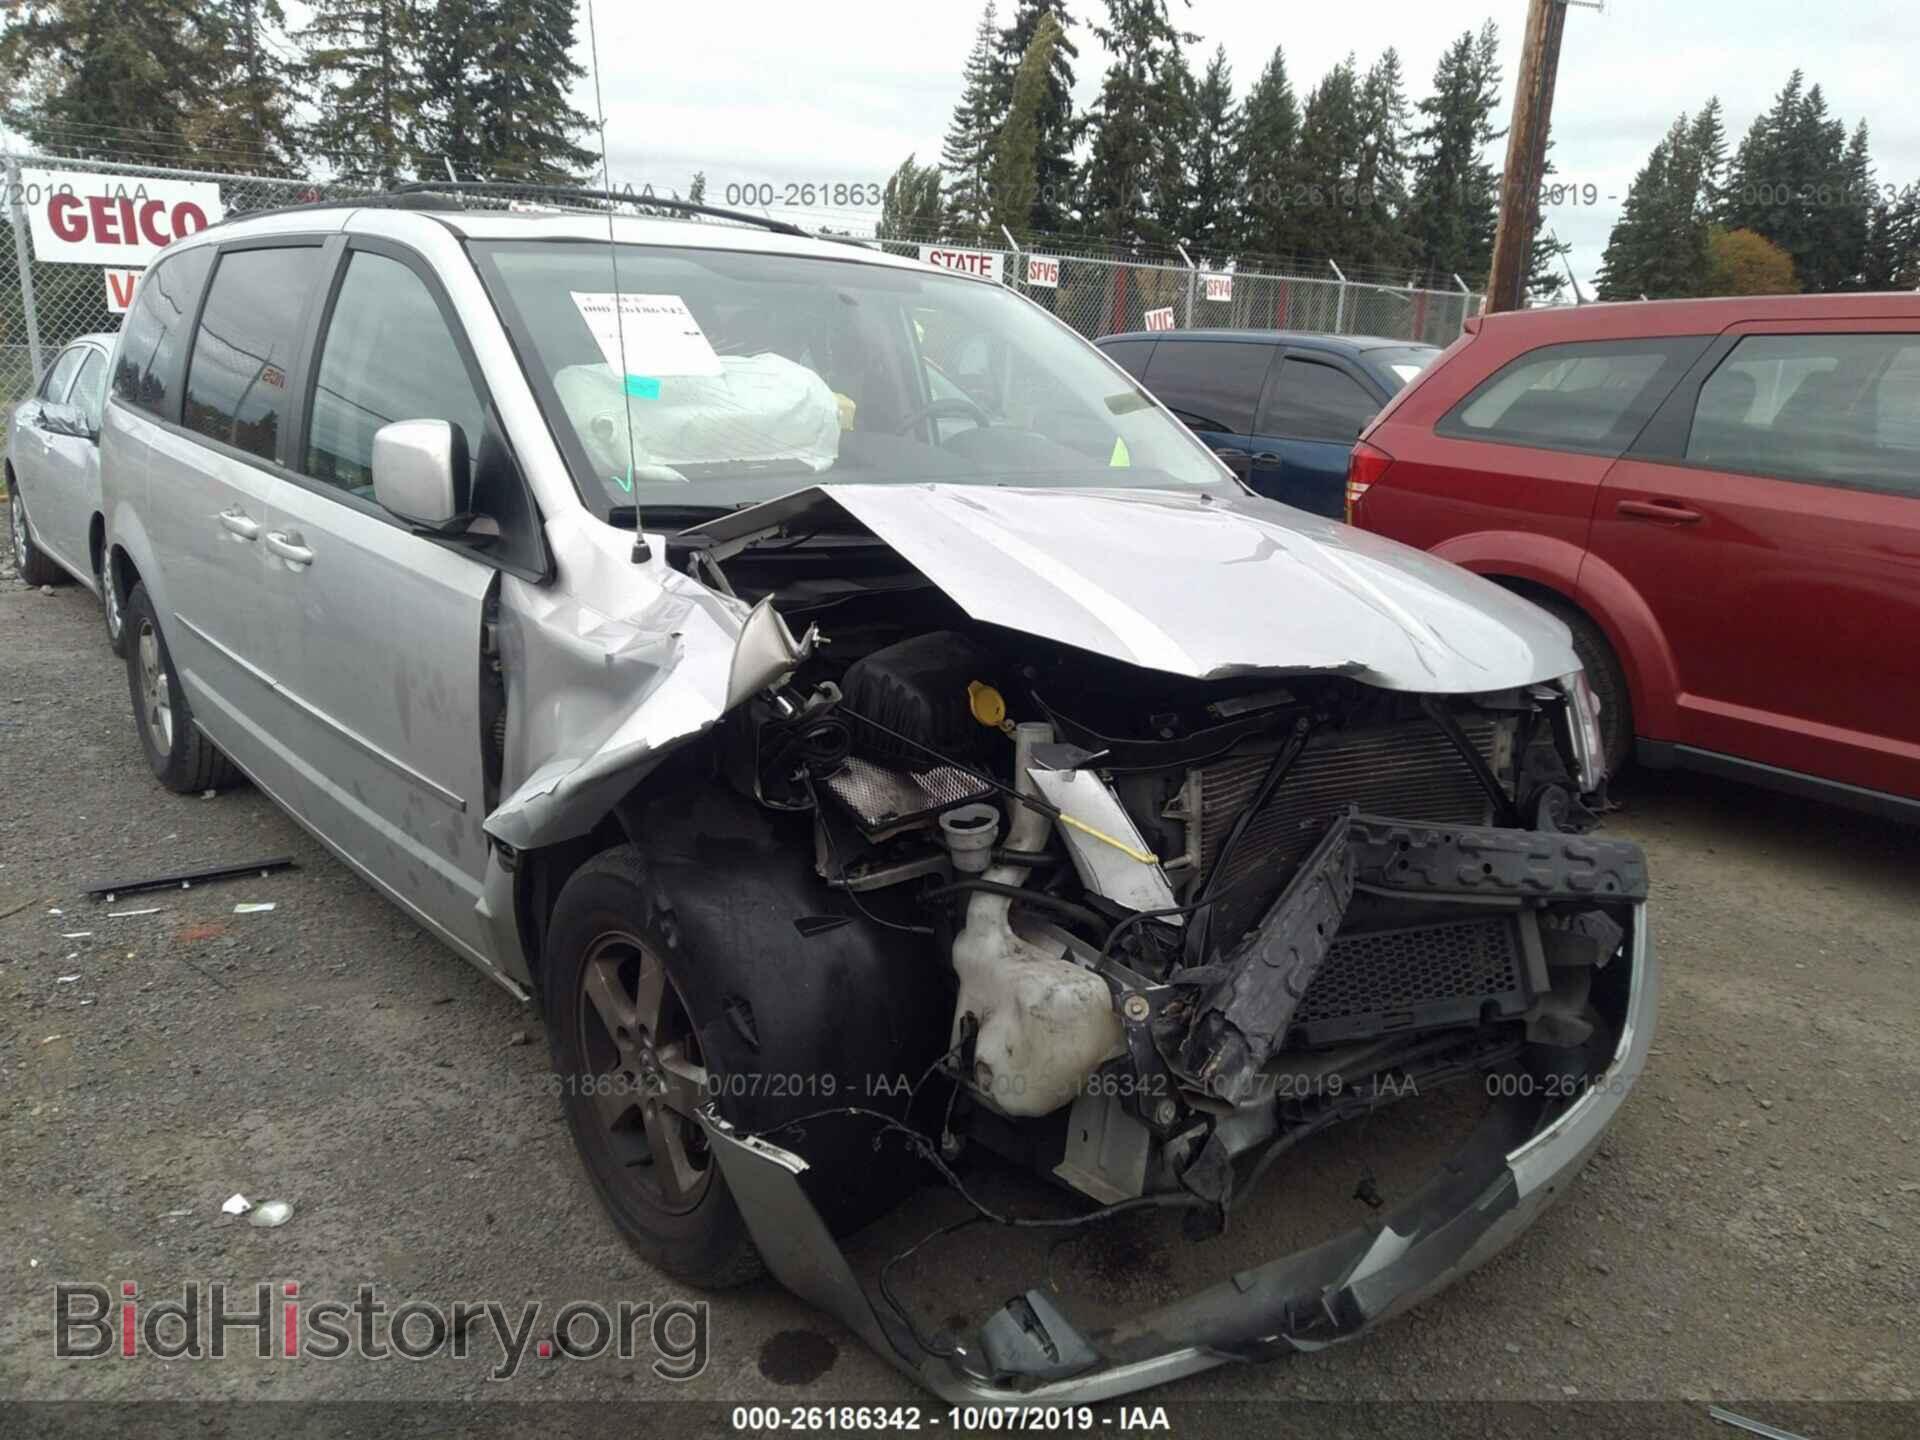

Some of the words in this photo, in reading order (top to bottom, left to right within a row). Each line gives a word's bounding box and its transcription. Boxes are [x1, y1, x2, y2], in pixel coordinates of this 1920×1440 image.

[47, 192, 208, 247] GEICO
[930, 251, 993, 278] STATE
[1207, 279, 1232, 297] SFV4
[1146, 310, 1174, 331] VIC
